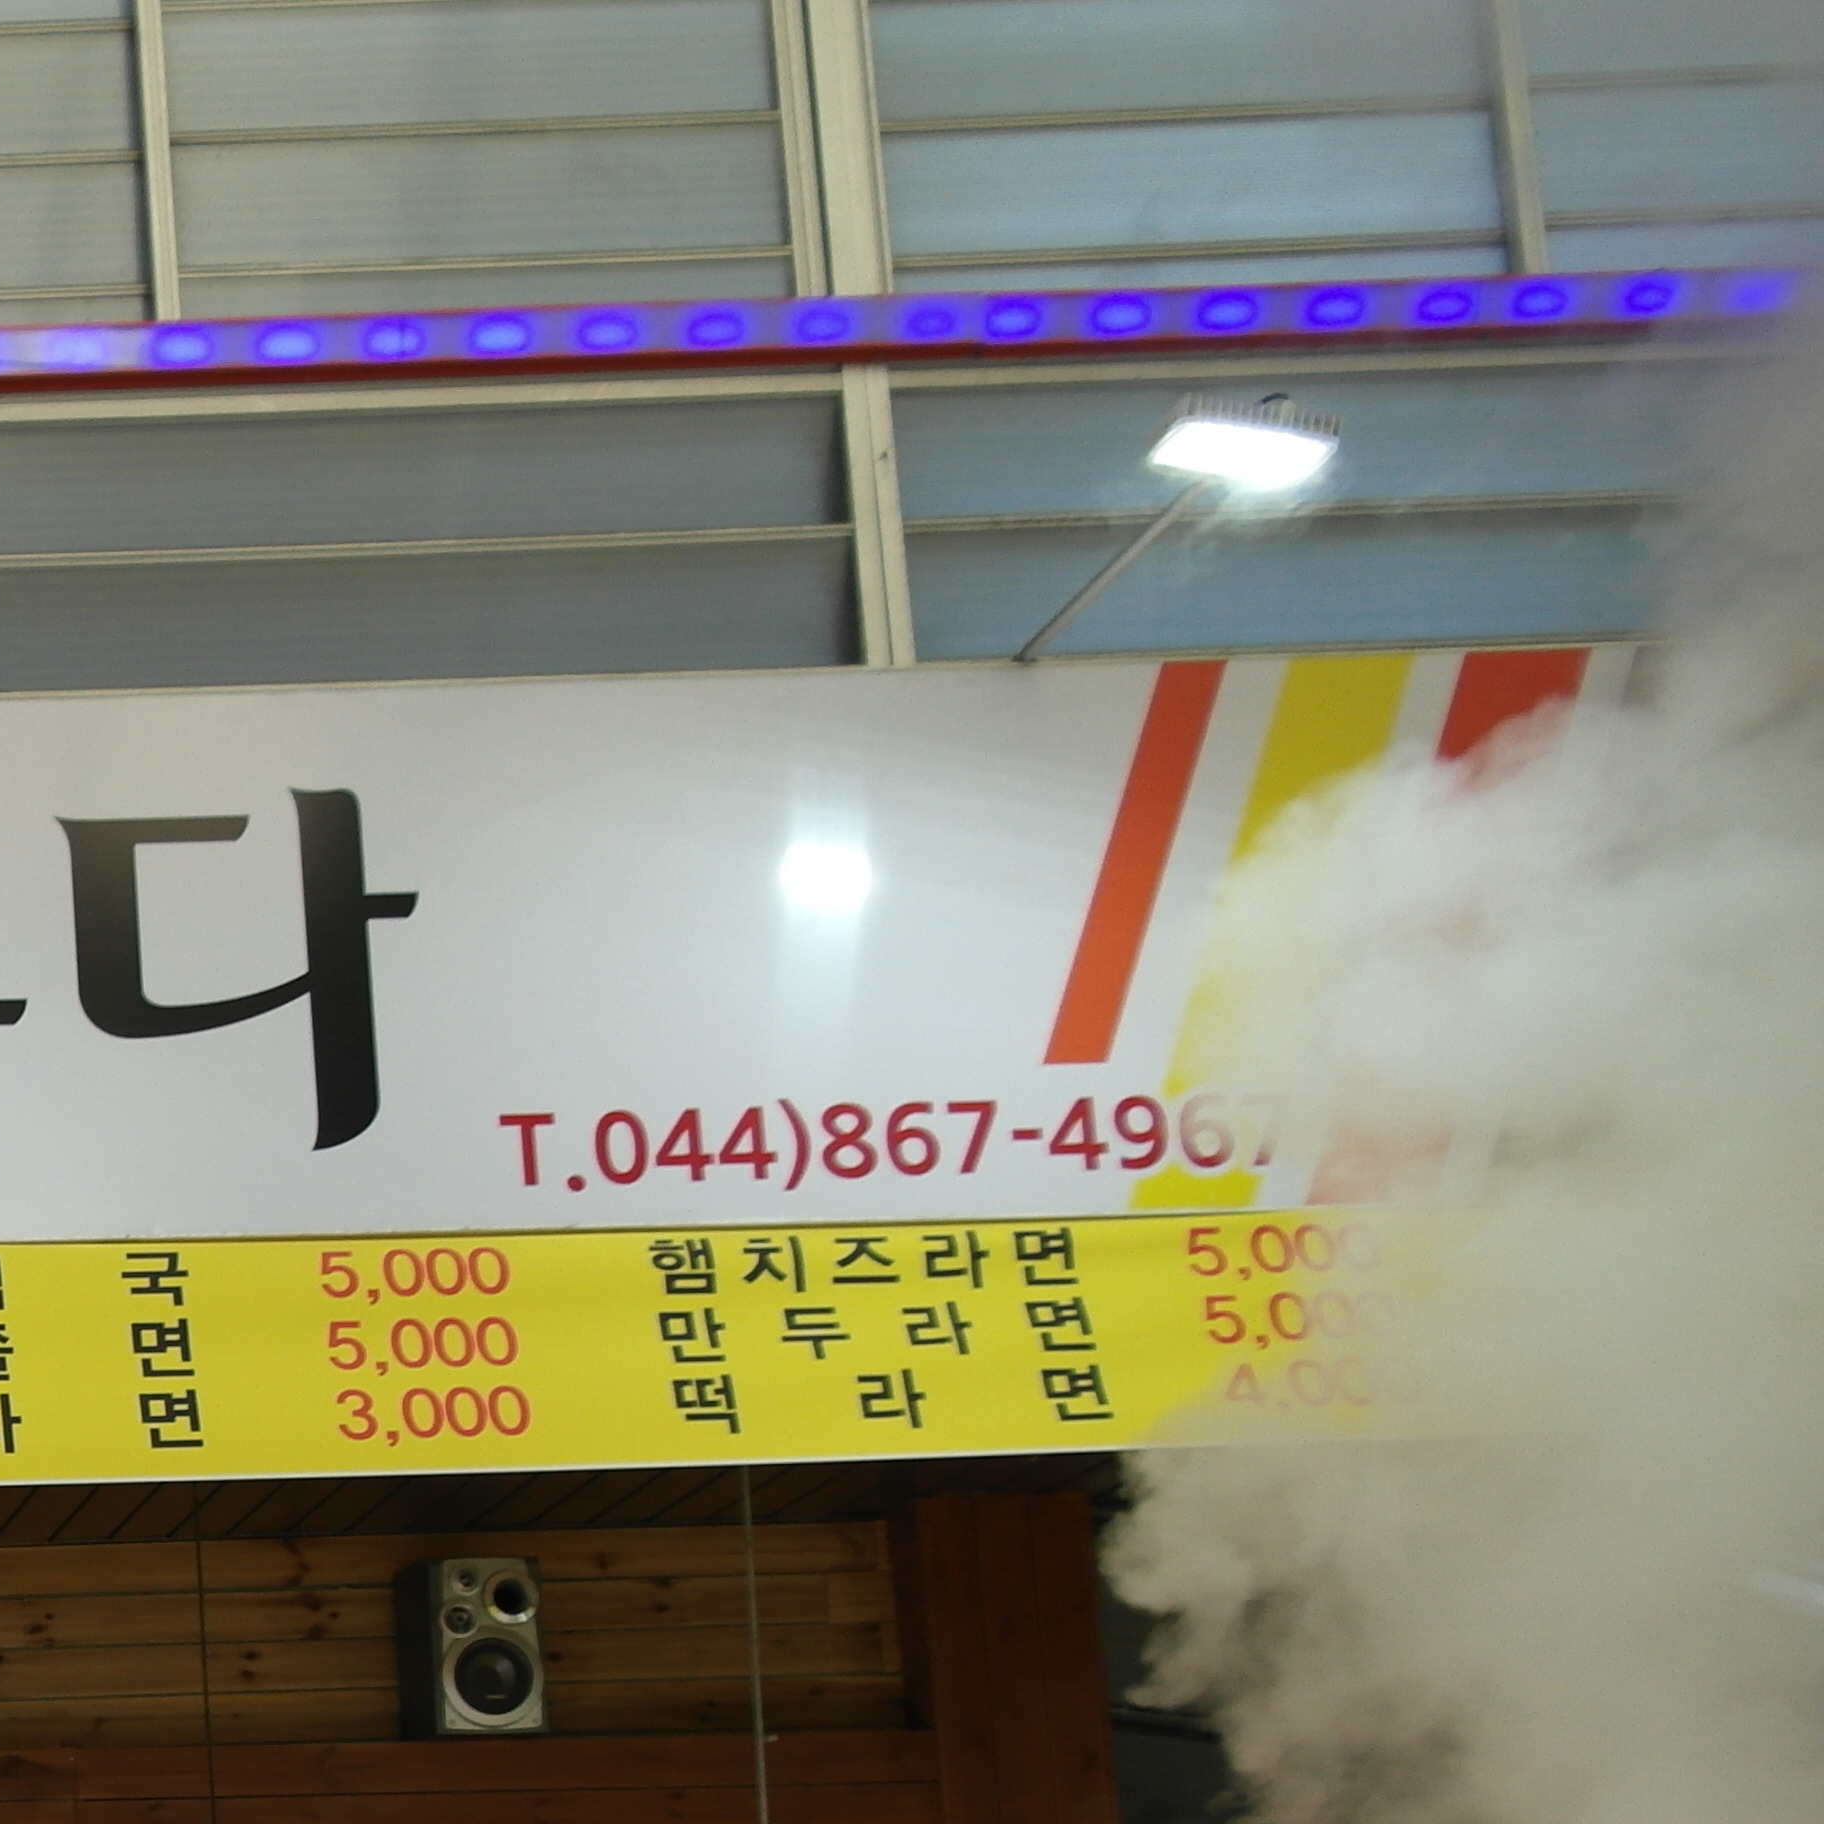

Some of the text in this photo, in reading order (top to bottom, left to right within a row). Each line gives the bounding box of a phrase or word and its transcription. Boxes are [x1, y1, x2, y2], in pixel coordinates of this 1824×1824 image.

[319, 1247, 510, 1305] 5,000
[651, 1231, 1076, 1295] 햄치즈라면
[327, 1317, 519, 1376] 5,000
[661, 1291, 1398, 1363] 만두라면 5,00
[1225, 1358, 1374, 1407] 4,00
[335, 1386, 531, 1447] 3,000
